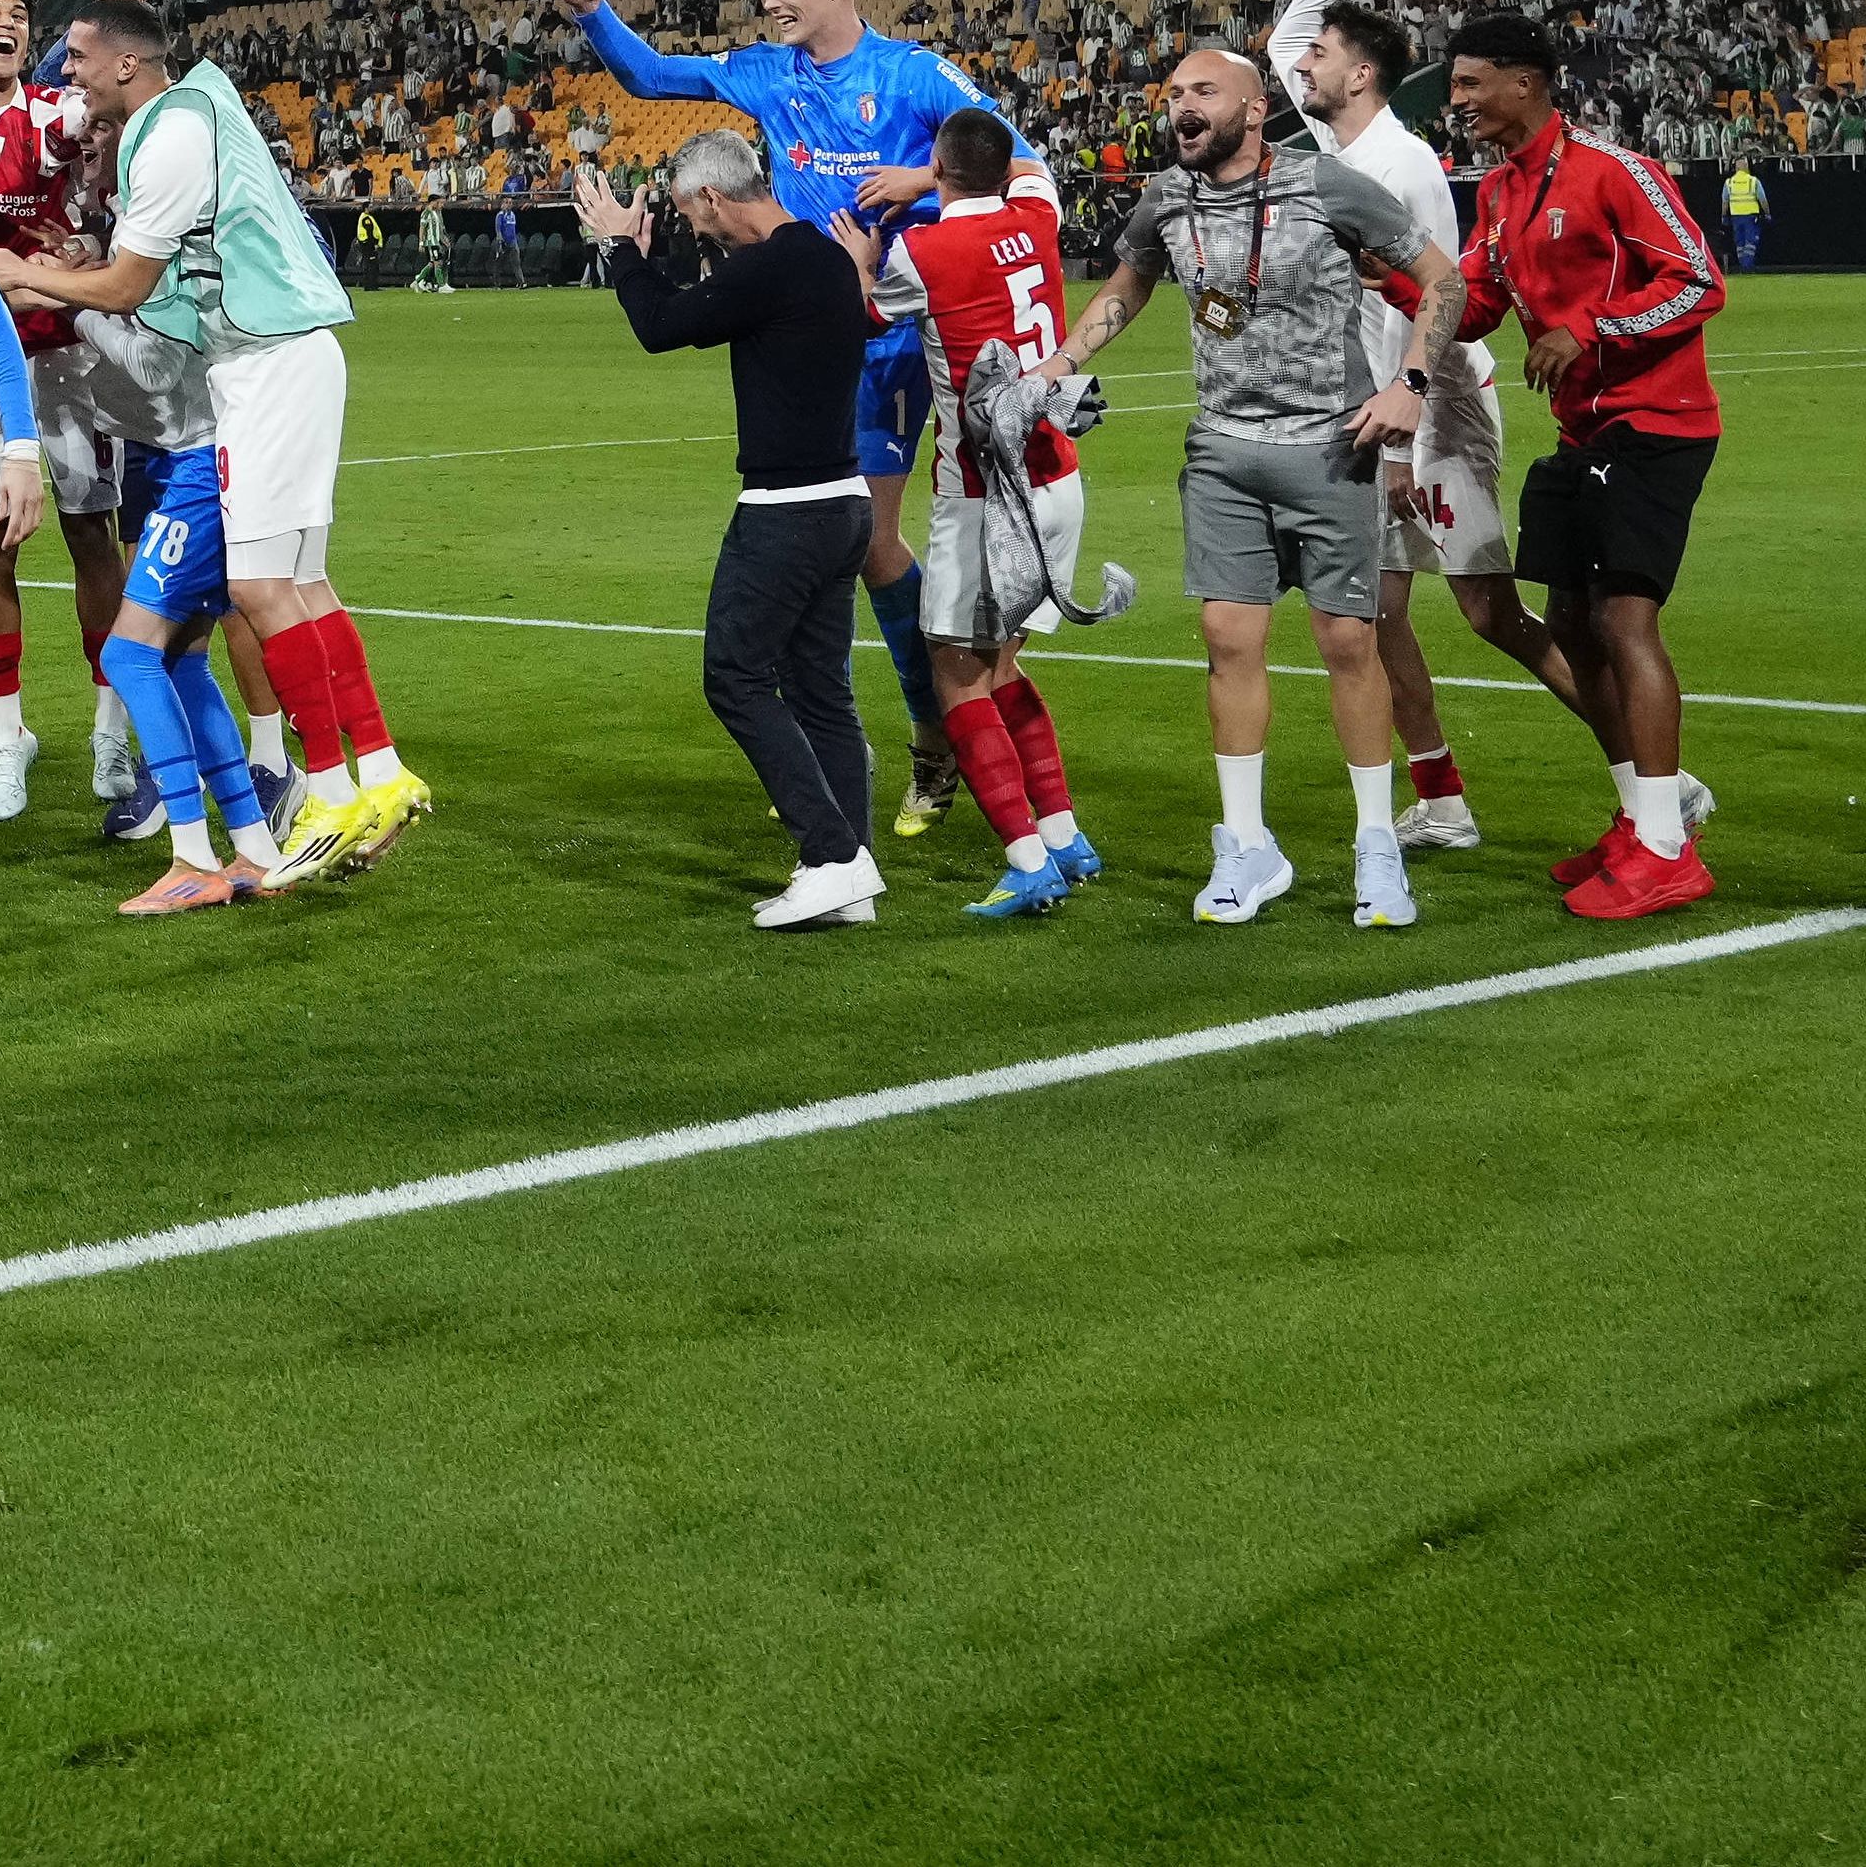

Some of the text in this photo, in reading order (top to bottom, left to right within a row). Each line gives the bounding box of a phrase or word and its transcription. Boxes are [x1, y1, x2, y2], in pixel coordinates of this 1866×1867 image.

[813, 147, 881, 166] Portuguese
[813, 161, 835, 175] Red
[990, 231, 1035, 266] LELO
[1004, 263, 1058, 373] 5
[893, 388, 906, 436] 1
[143, 513, 189, 567] 78
